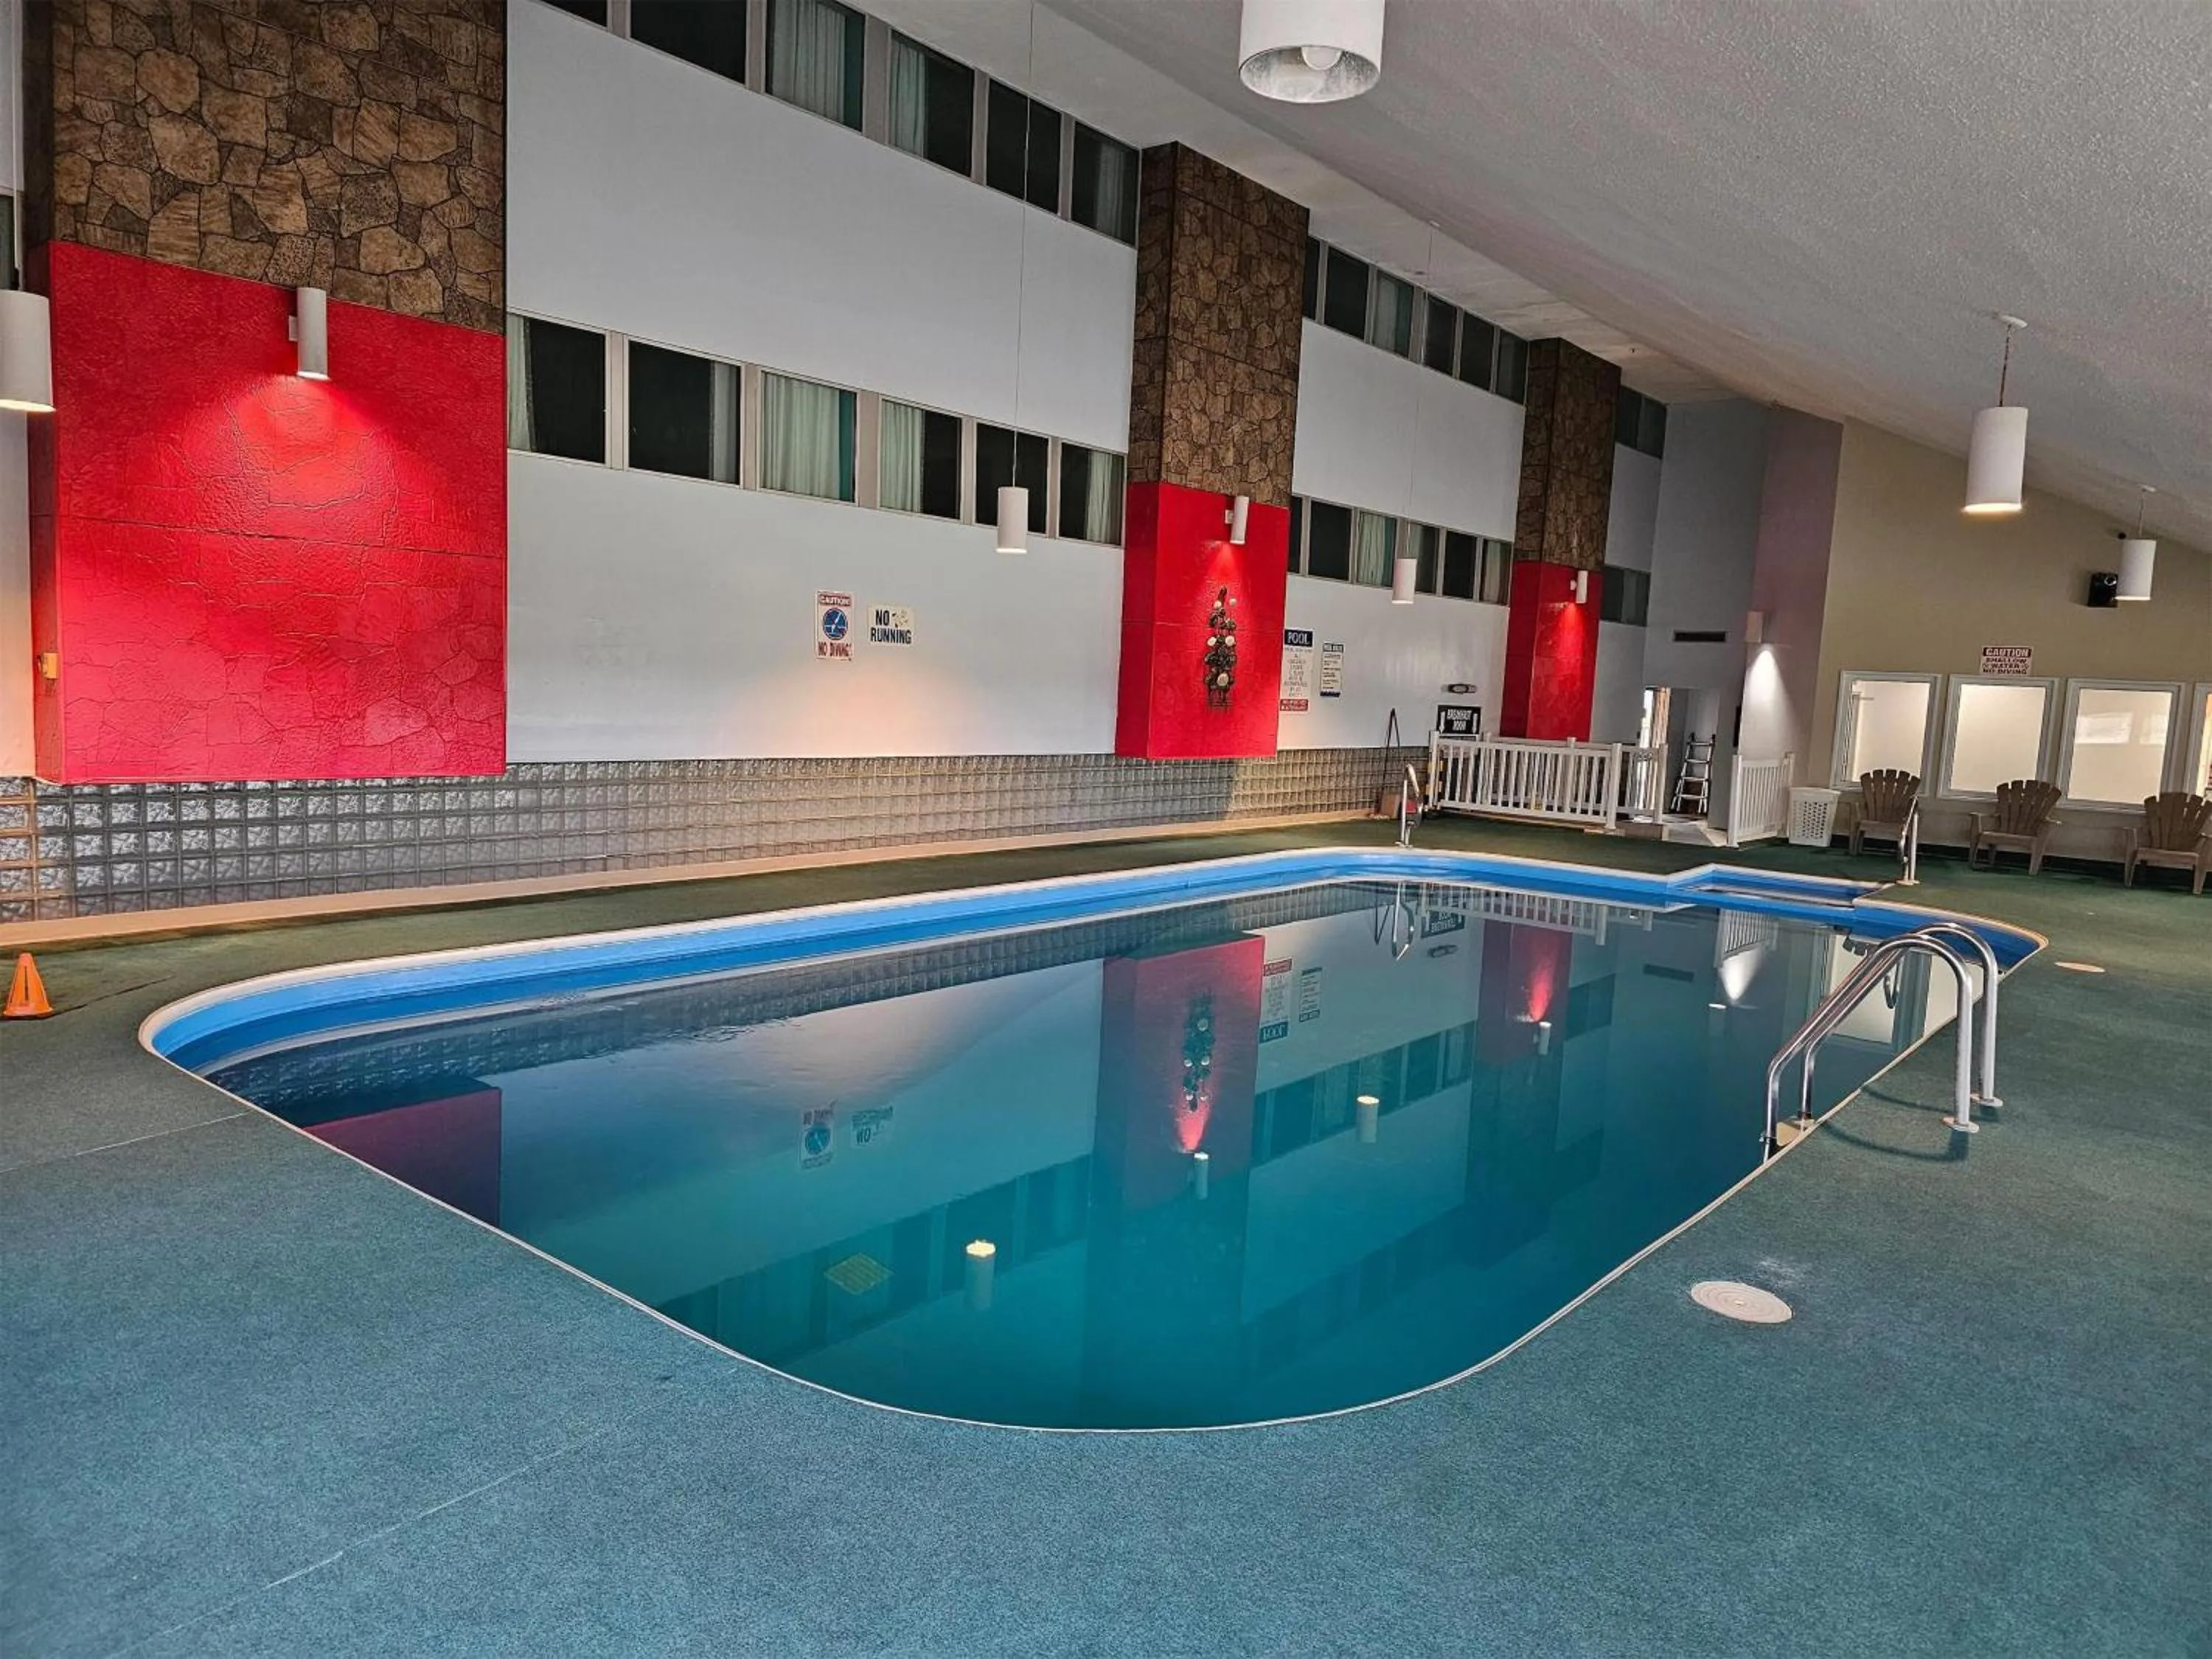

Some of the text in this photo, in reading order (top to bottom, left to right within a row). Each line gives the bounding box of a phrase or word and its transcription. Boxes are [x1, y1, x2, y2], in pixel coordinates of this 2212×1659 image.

[819, 594, 850, 606] CAUTION
[875, 610, 889, 625] NO
[870, 627, 912, 644] RUNNING
[1287, 632, 1310, 644] POOL
[818, 641, 828, 656] NO
[830, 643, 852, 657] DIVING
[1986, 648, 2028, 657] CAUTION
